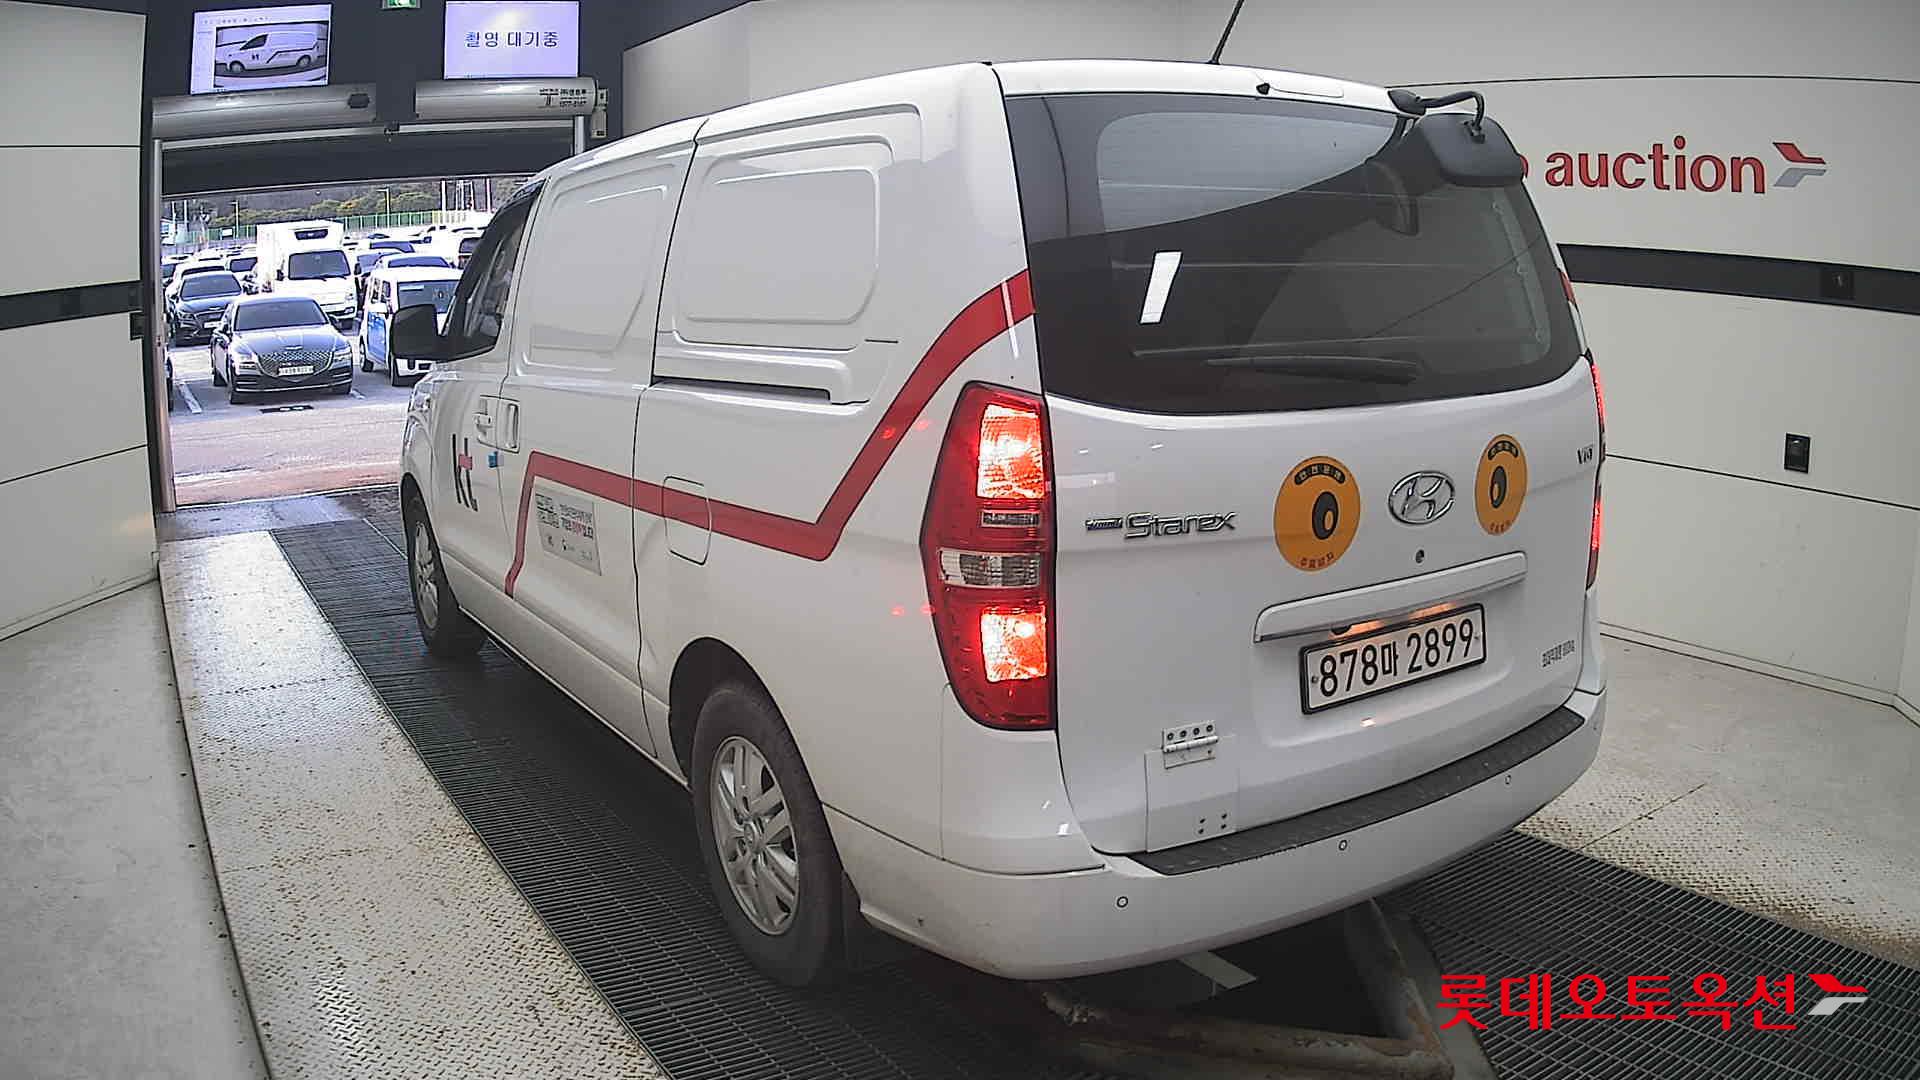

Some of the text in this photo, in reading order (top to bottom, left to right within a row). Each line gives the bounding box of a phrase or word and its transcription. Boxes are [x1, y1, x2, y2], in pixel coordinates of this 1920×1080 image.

[507, 31, 559, 48] 대기중
[1544, 135, 1766, 194] auction
[1125, 512, 1237, 539] Starex
[1319, 641, 1399, 697] 878마
[1406, 618, 1474, 674] 2899
